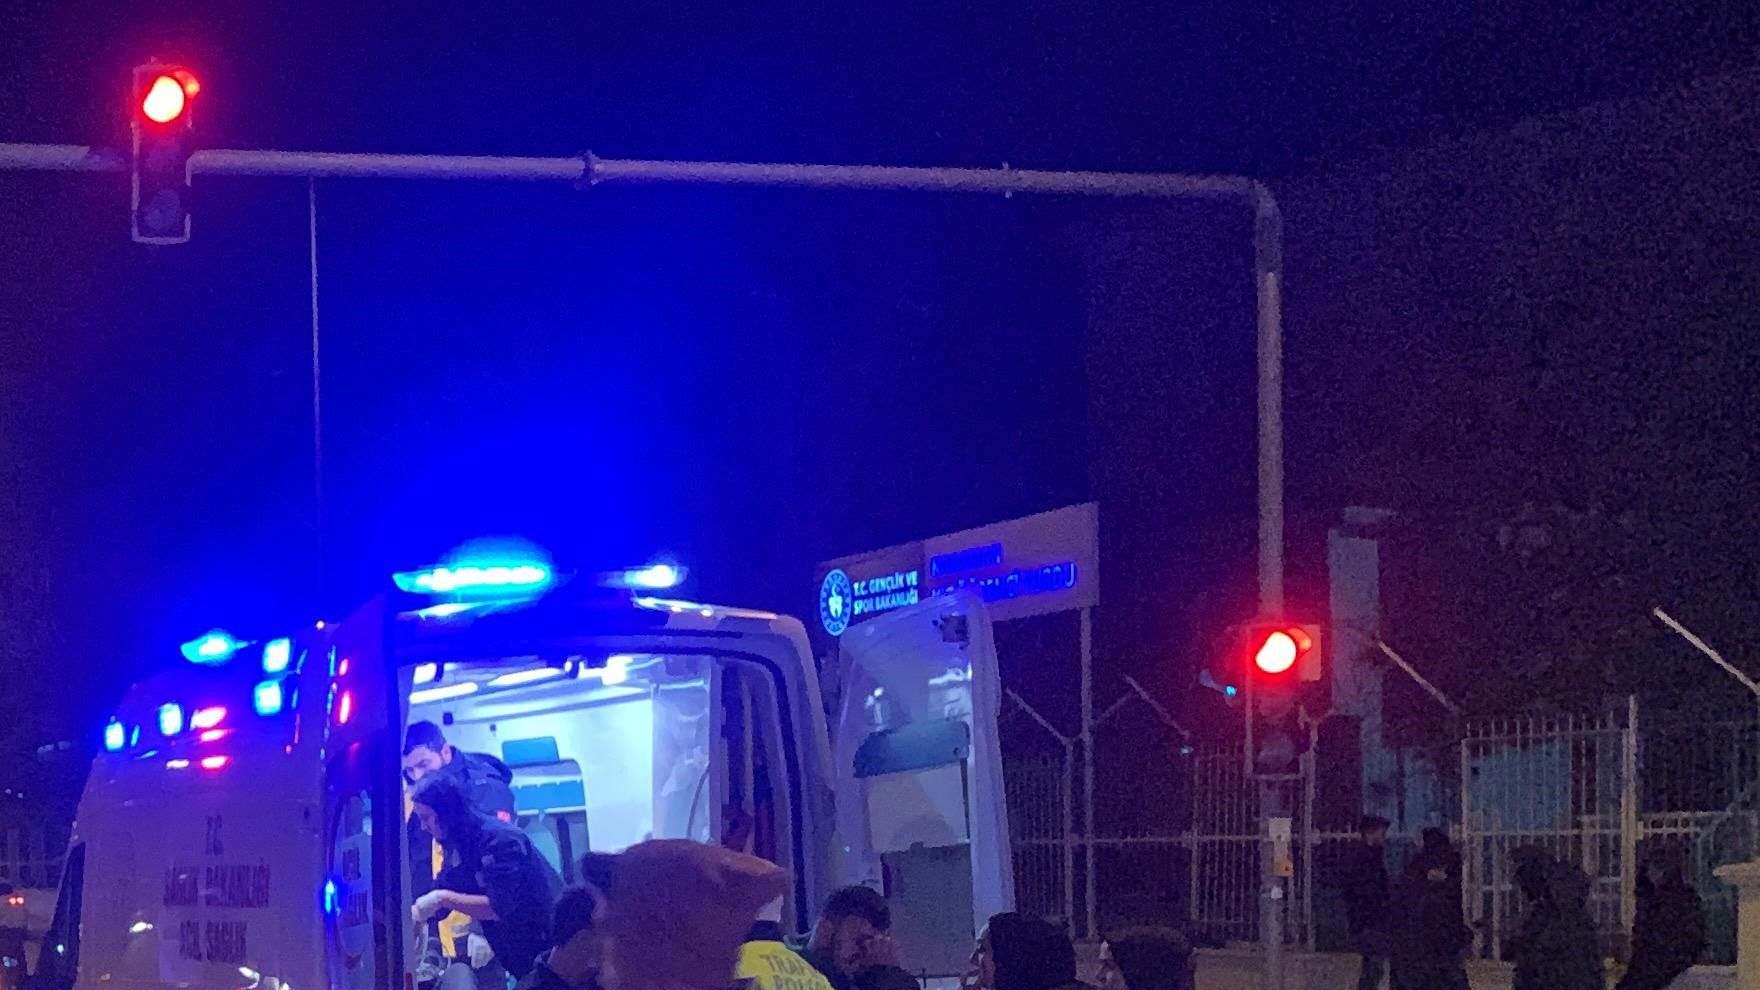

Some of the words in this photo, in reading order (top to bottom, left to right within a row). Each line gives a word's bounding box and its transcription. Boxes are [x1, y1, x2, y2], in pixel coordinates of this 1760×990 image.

[869, 572, 905, 593] GENÇLİK
[906, 570, 918, 586] VE
[853, 598, 874, 615] SPOR
